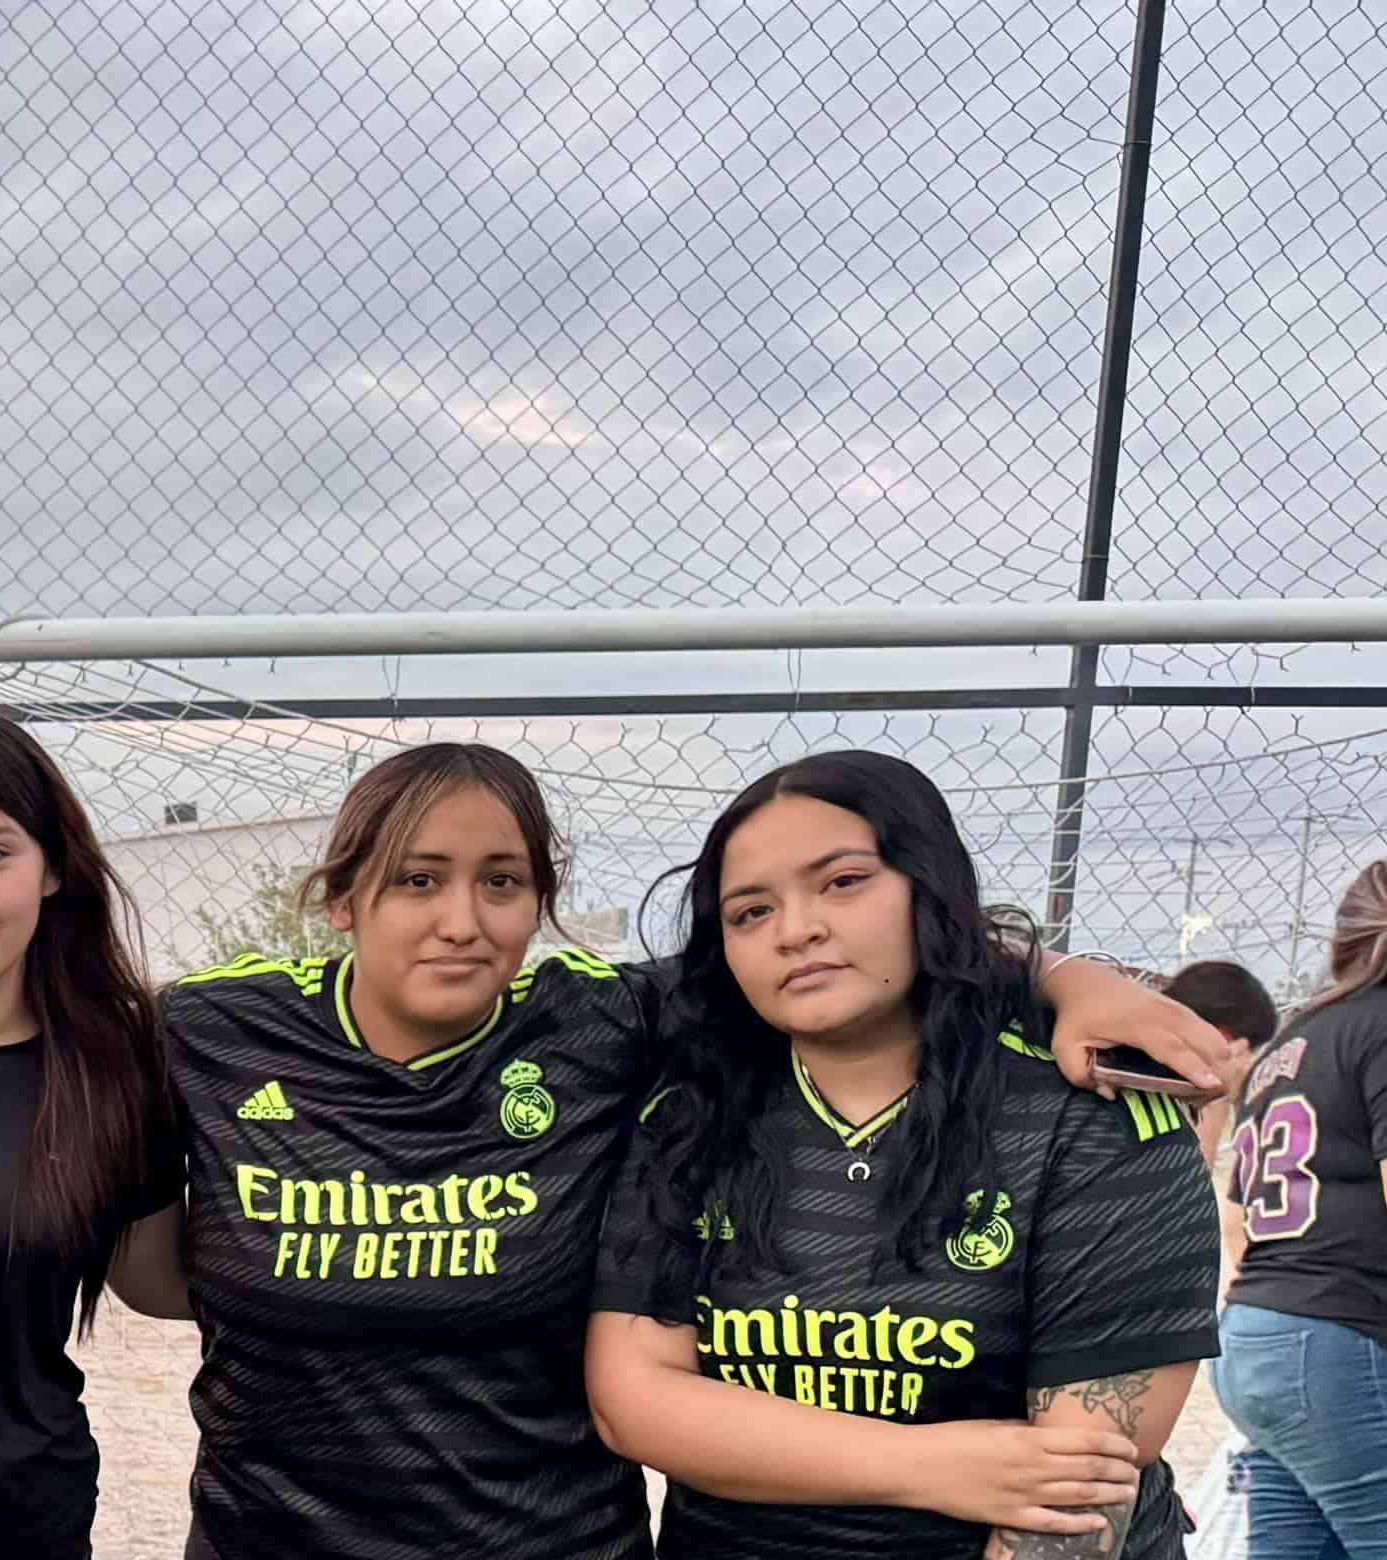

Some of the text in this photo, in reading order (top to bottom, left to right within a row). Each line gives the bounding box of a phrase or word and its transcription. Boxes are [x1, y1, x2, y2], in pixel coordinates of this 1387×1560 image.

[237, 1106, 295, 1120] adidas
[235, 1163, 539, 1226] Emirates
[273, 1229, 498, 1280] FLY BETTER
[793, 1363, 925, 1417] BETTER
